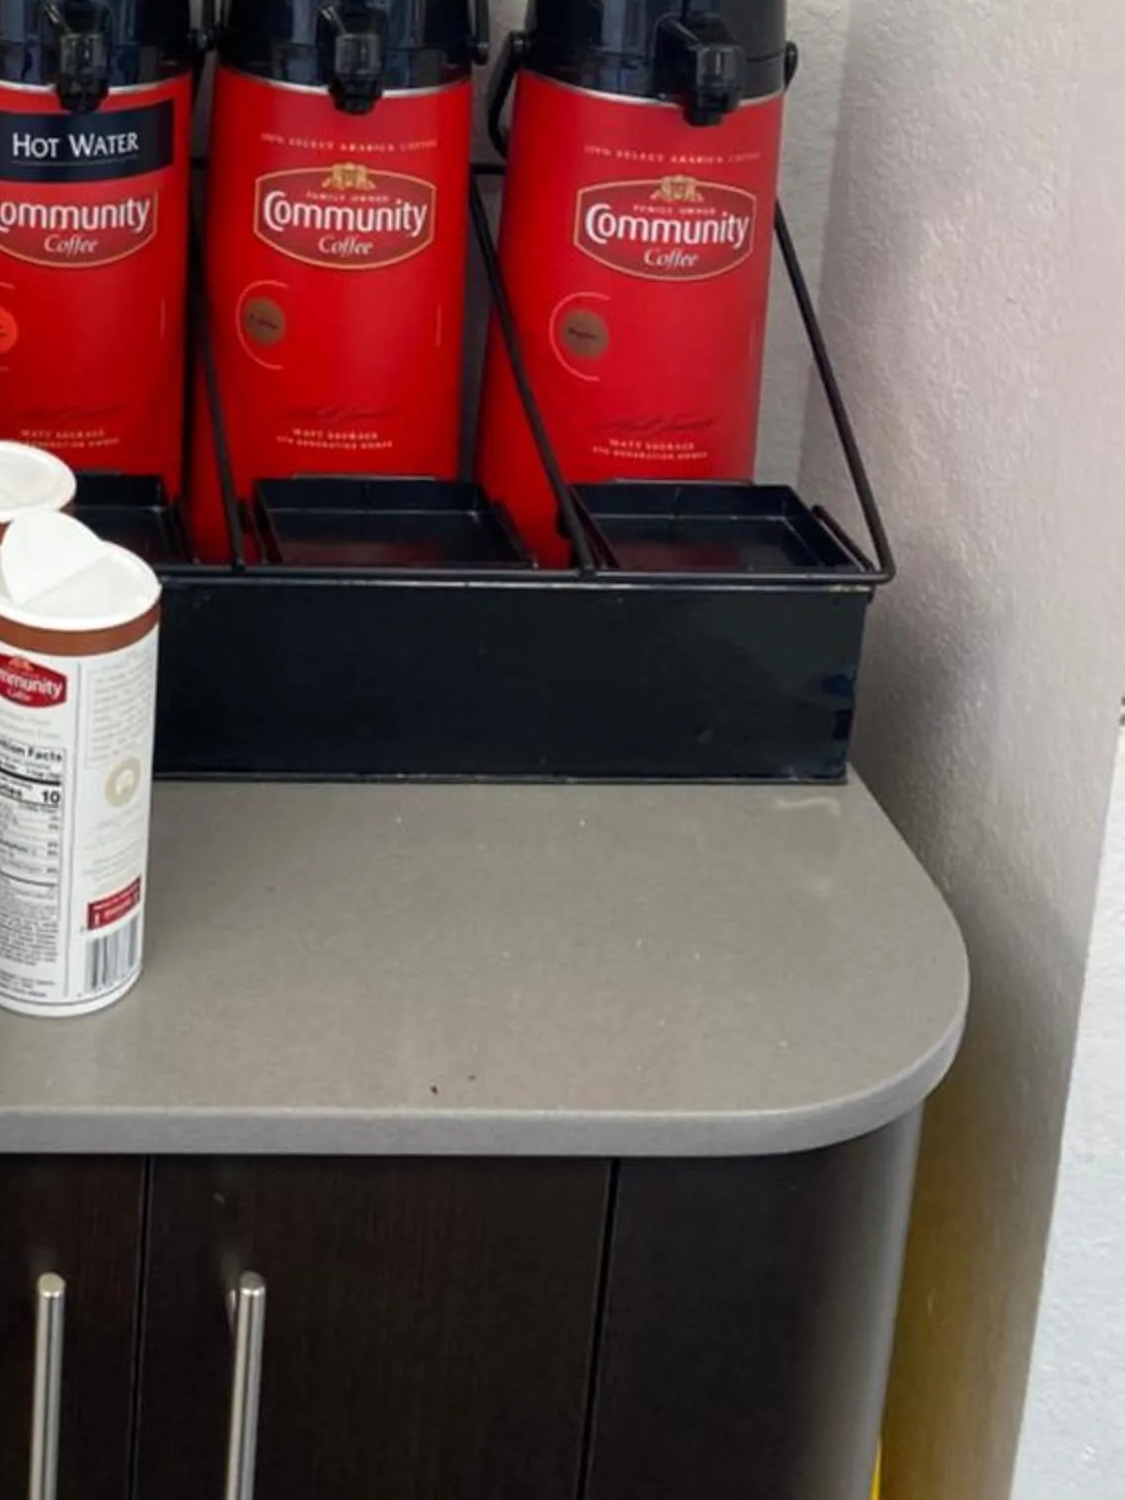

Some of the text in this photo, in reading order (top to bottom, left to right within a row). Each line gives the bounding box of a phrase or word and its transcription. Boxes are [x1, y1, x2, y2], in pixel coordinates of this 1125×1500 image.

[263, 190, 428, 238] Community
[585, 203, 750, 251] Community
[43, 233, 99, 257] Coffee
[318, 234, 374, 258] Coffee
[643, 248, 700, 270] Coffee
[27, 746, 63, 763] Facts
[41, 790, 61, 804] 10
